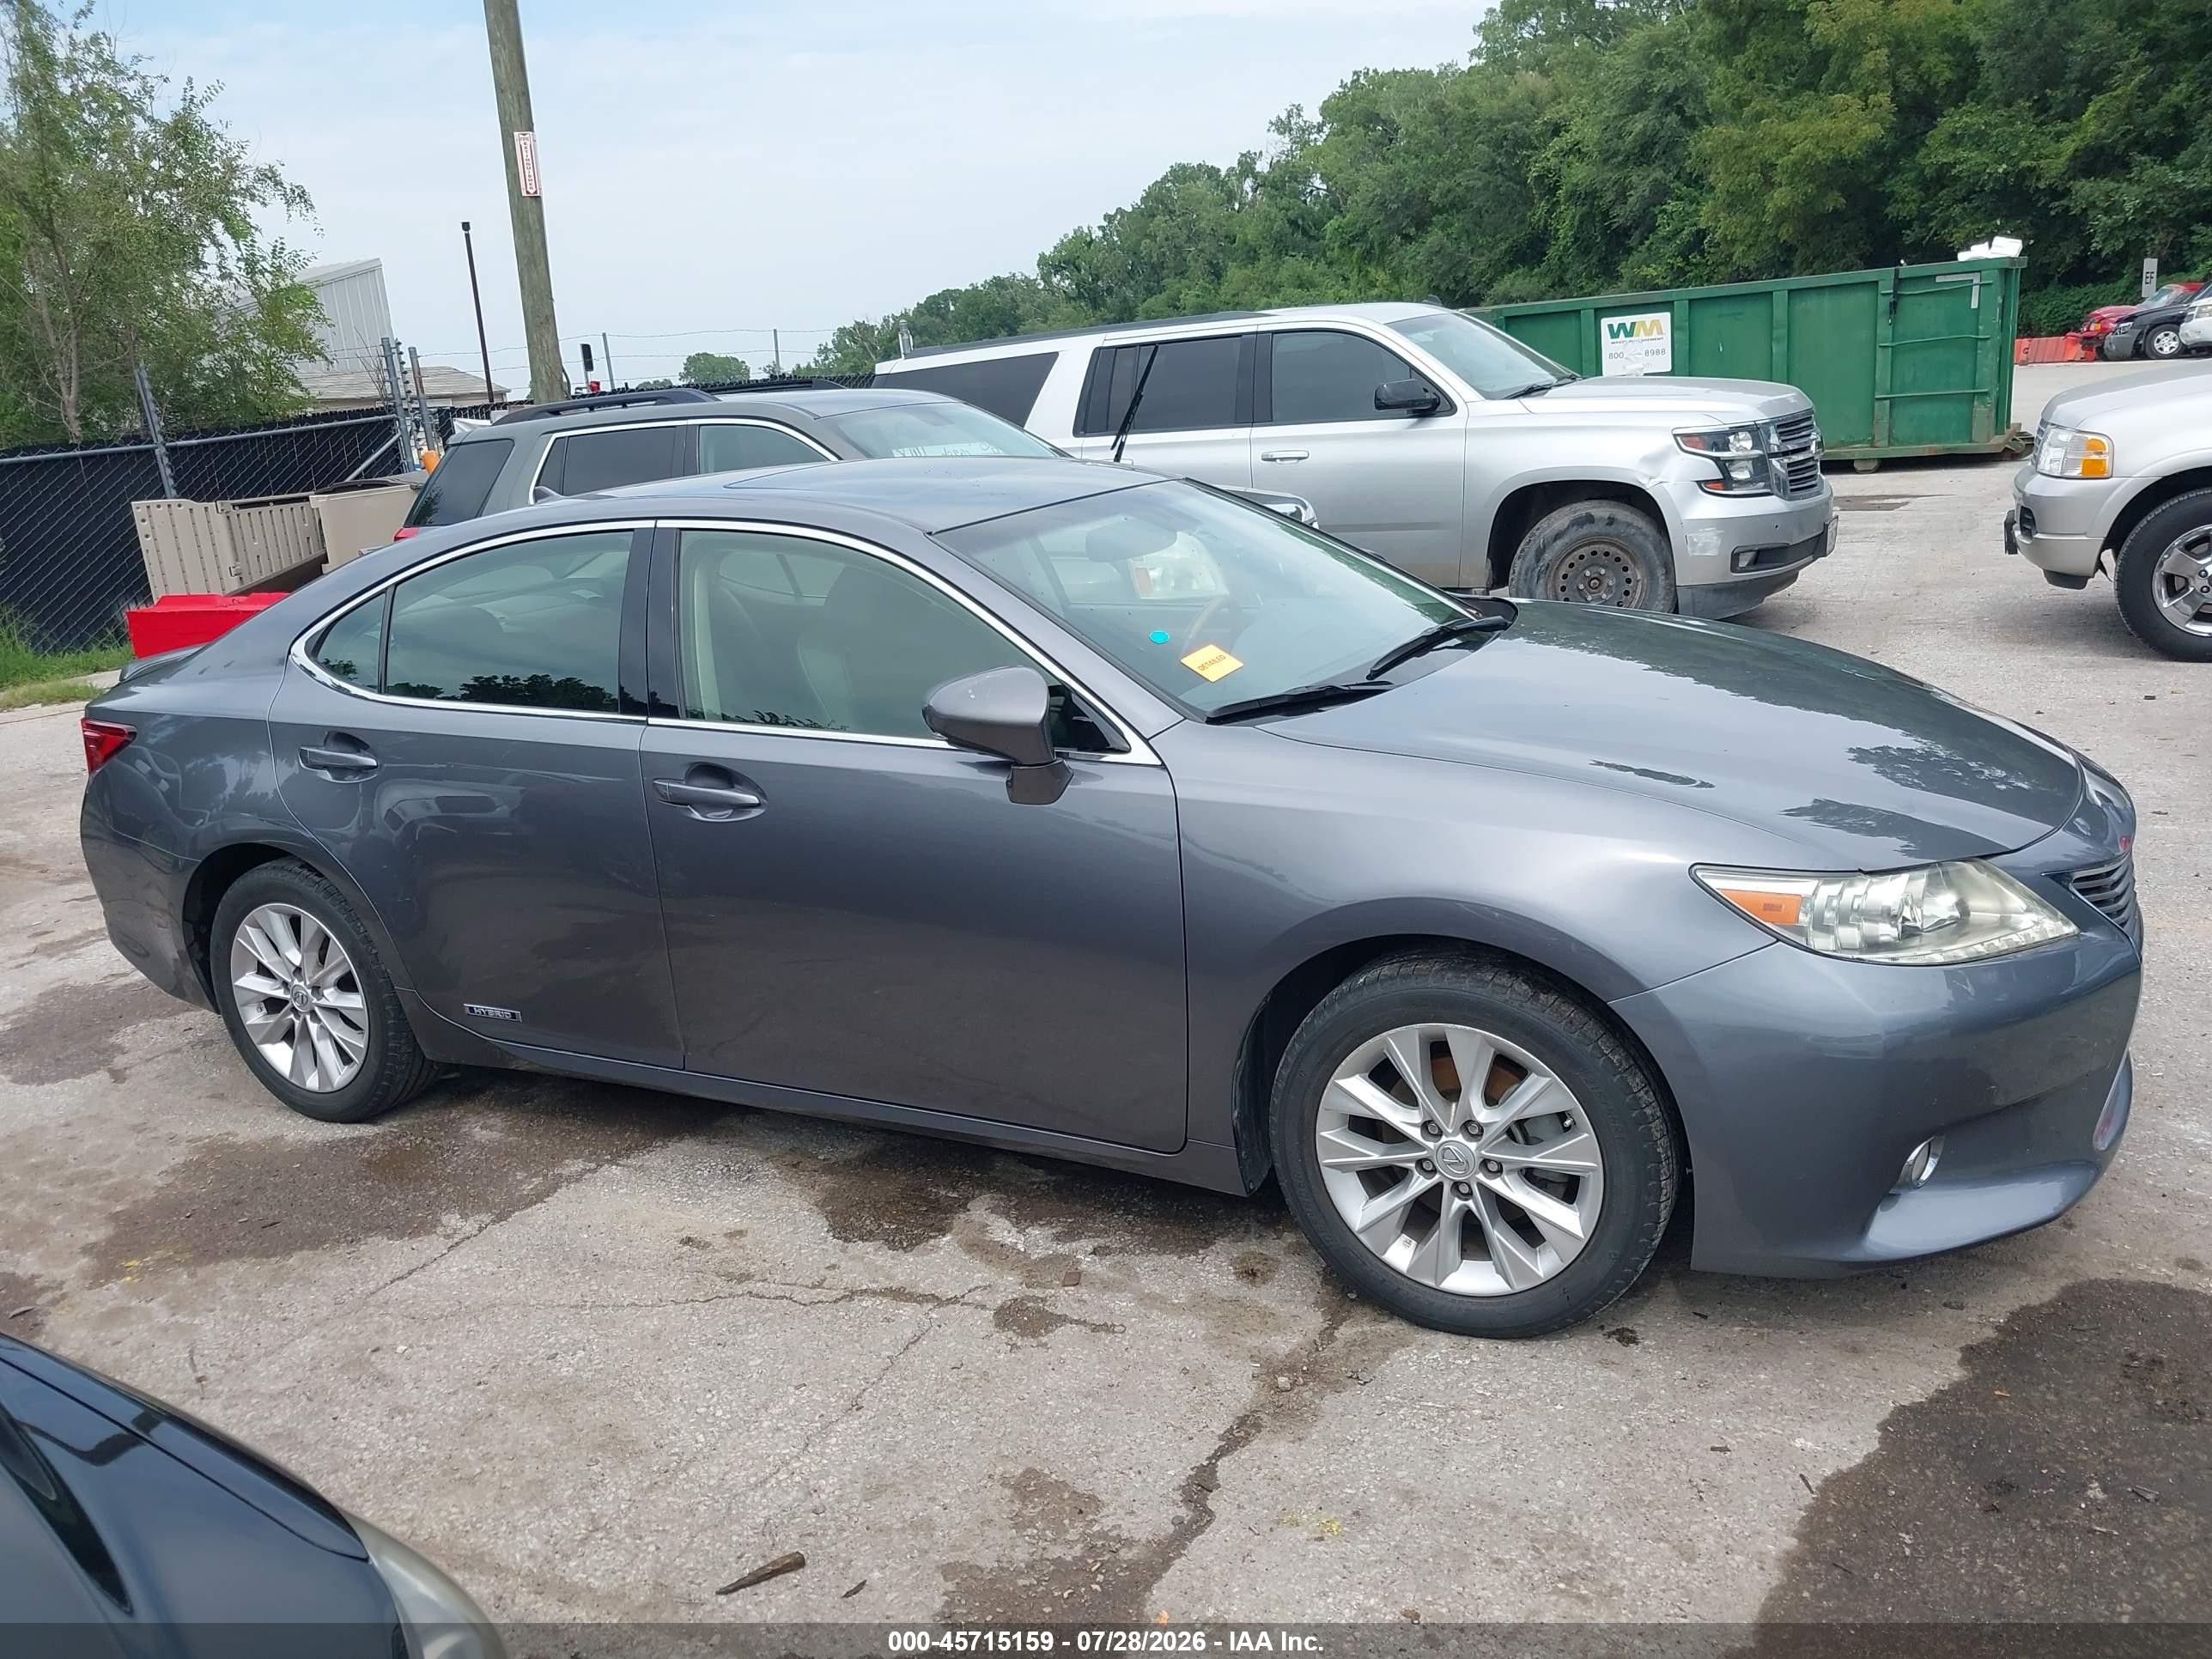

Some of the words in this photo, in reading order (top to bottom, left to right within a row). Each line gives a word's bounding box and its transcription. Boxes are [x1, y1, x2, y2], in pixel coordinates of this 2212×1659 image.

[2145, 271, 2154, 284] EF
[1607, 319, 1663, 339] WM
[1644, 348, 1666, 357] 8988
[474, 1007, 511, 1018] HYBRID
